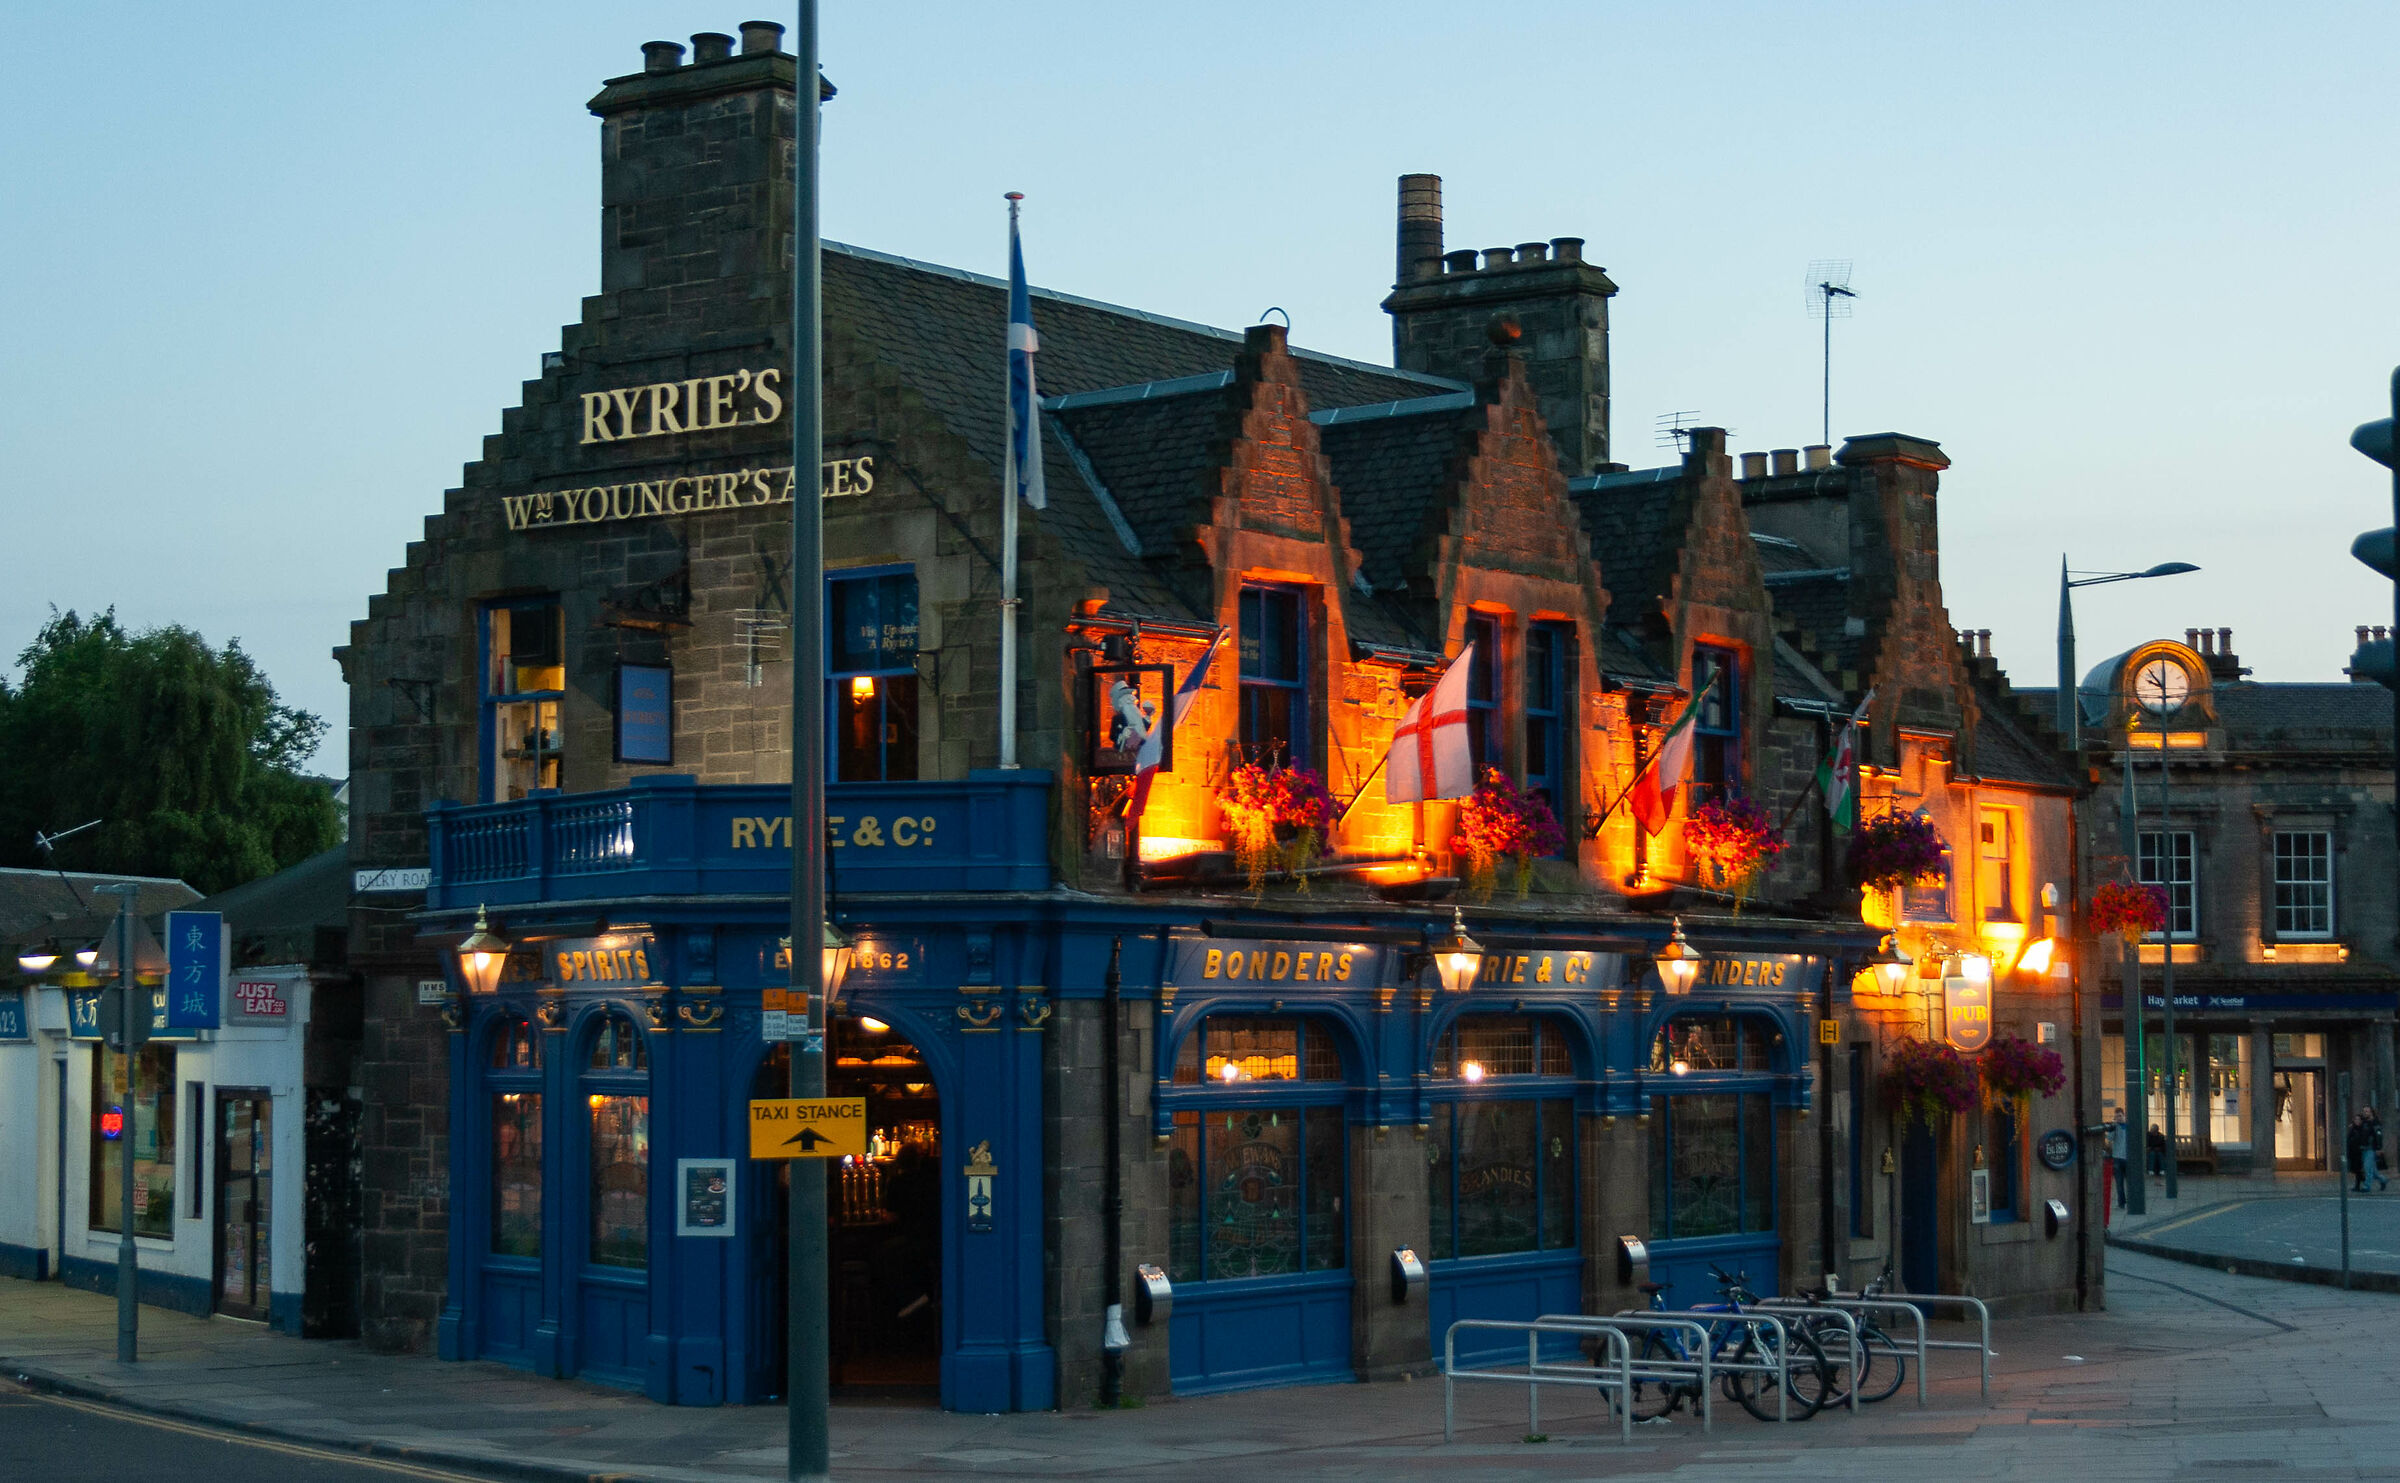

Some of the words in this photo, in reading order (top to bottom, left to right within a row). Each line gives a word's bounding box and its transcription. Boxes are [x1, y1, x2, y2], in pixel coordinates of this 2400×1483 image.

[580, 367, 783, 445] RYRIE'S
[561, 469, 773, 525] YOUNGER'S
[779, 456, 874, 502] AES
[731, 816, 847, 848] RYE
[853, 816, 885, 848] &
[360, 873, 397, 888] DALRY
[181, 924, 208, 1016] 東方城
[557, 950, 650, 981] SPIRITS
[850, 952, 909, 969] 1862
[1203, 948, 1354, 982] BONDERS
[1483, 955, 1529, 983] RIE
[1535, 956, 1552, 983] &
[236, 983, 277, 999] JUST
[2147, 995, 2199, 1008] Hayarket
[246, 998, 275, 1013] EAT
[1952, 1005, 1987, 1021] PUB
[753, 1106, 789, 1120] TAXI
[796, 1104, 863, 1120] STANCE
